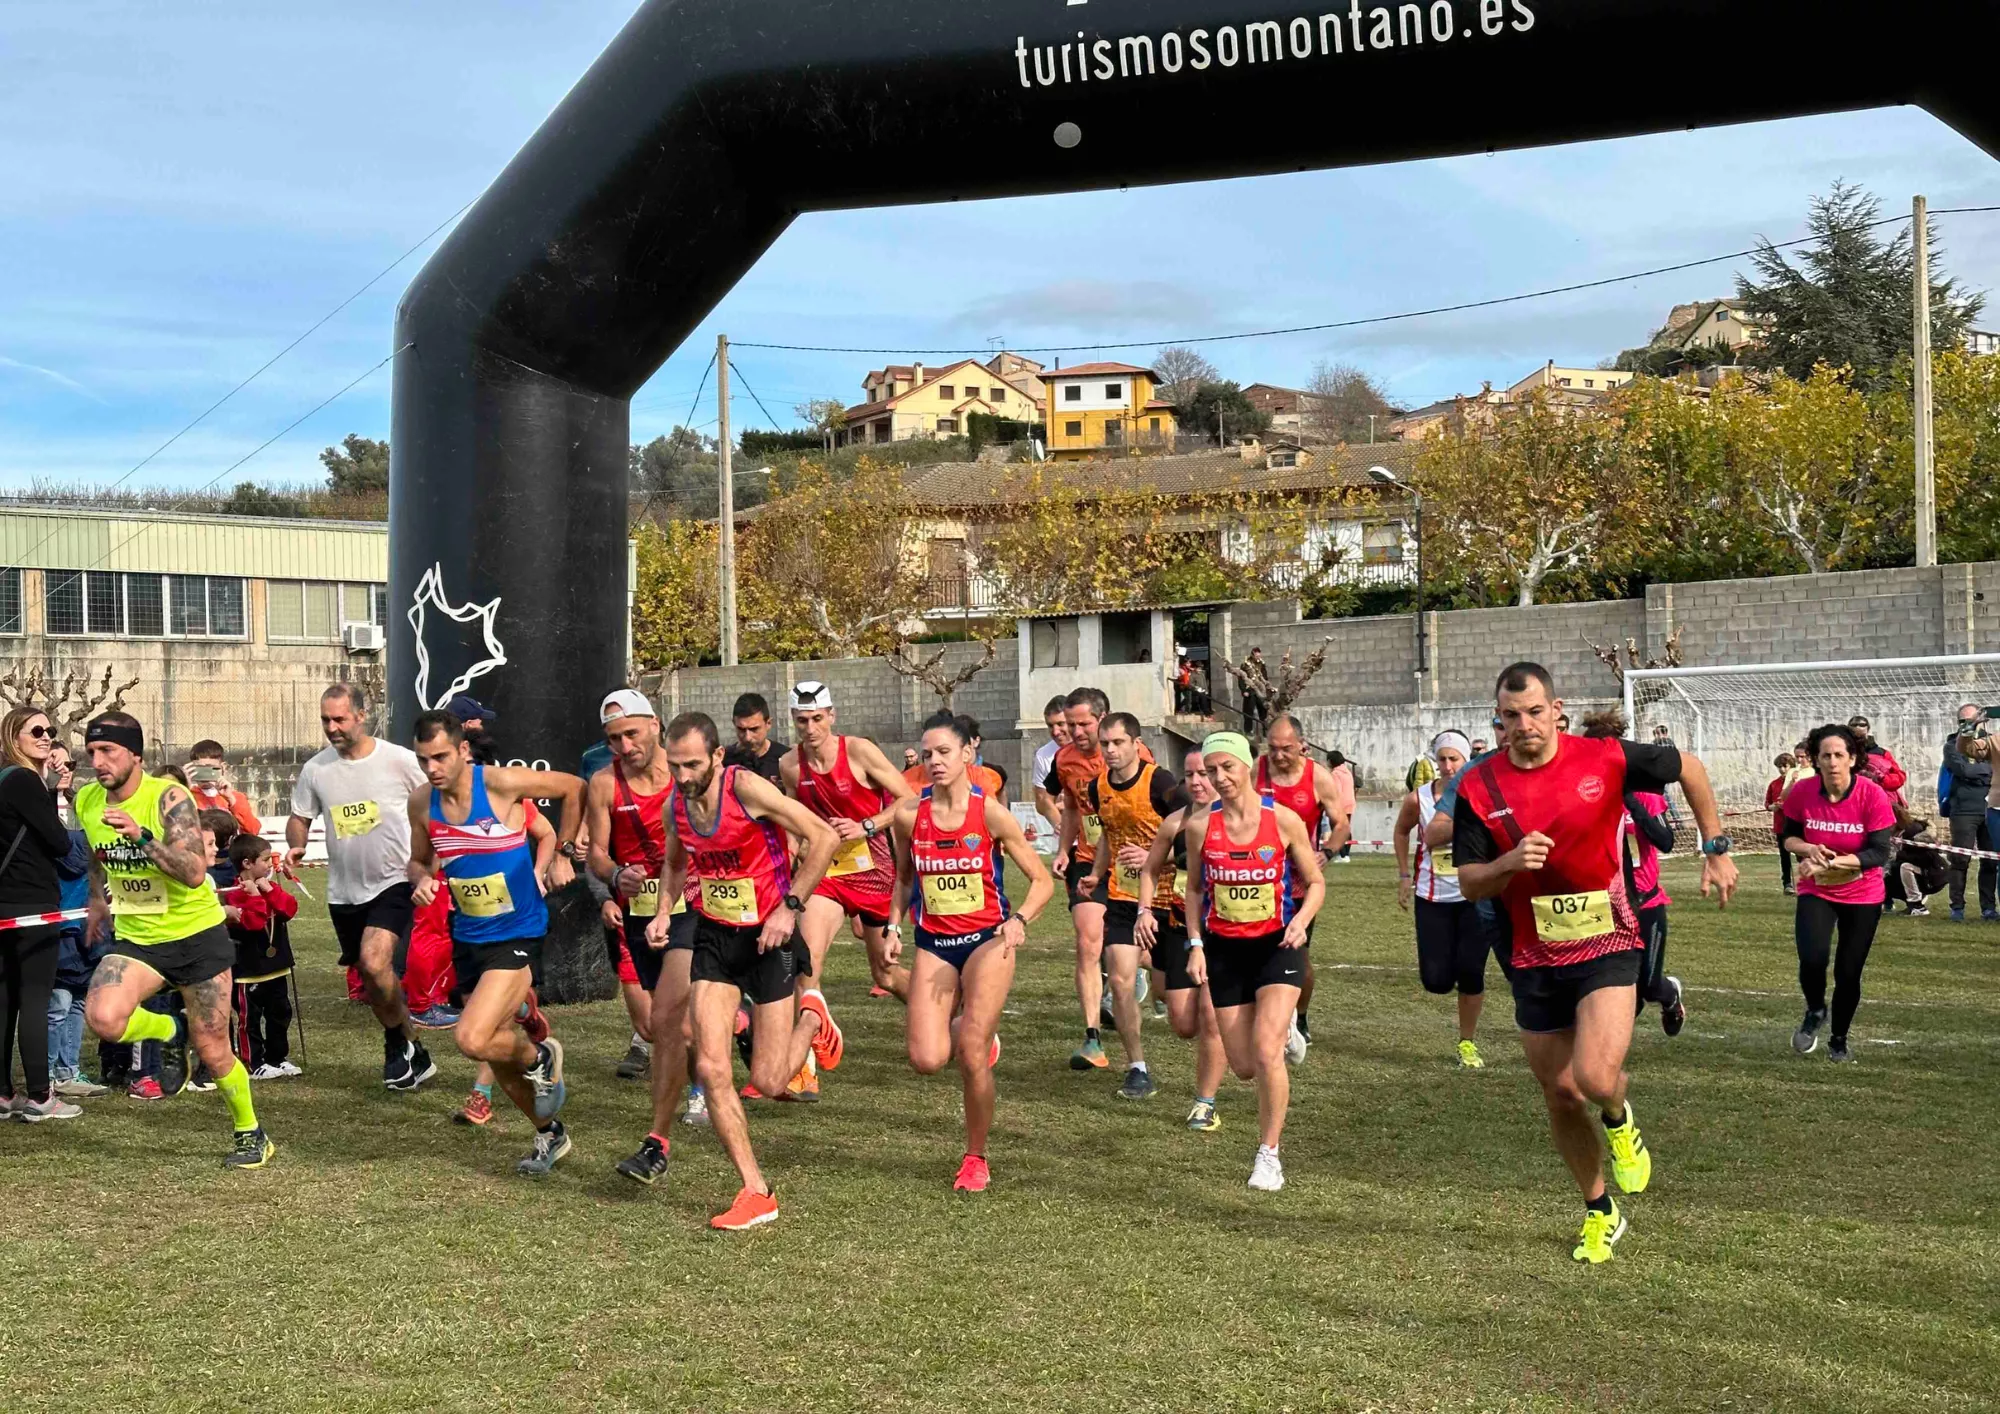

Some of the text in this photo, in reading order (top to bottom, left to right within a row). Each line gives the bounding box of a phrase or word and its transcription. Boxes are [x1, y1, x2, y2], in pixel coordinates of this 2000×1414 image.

[1015, 0, 1535, 87] turismosomontano.es
[342, 803, 366, 818] 038
[1088, 816, 1101, 827] 00
[1806, 819, 1864, 833] ZURDETAS
[915, 855, 983, 871] hinaco
[122, 879, 151, 892] 009
[461, 883, 490, 897] 291
[640, 881, 657, 894] 00
[937, 876, 967, 891] 004
[709, 884, 739, 899] 293
[1229, 887, 1260, 900] 002
[1552, 896, 1589, 915] 037
